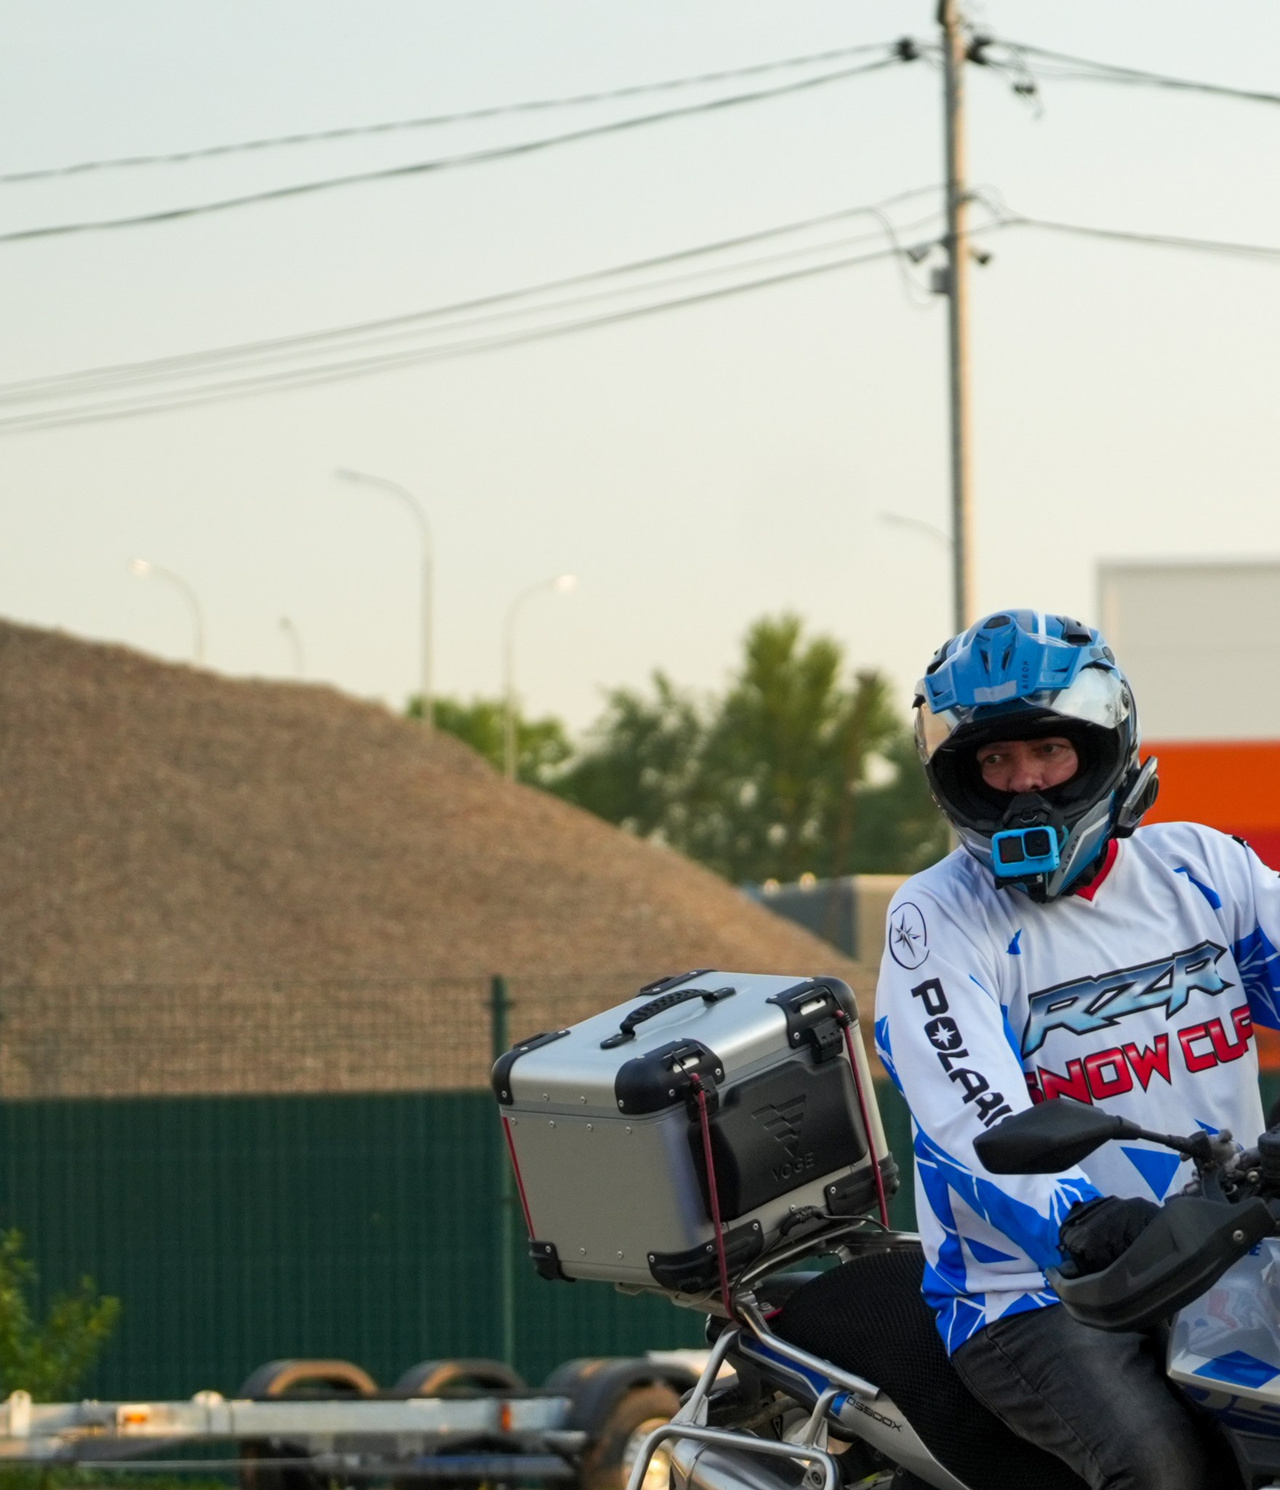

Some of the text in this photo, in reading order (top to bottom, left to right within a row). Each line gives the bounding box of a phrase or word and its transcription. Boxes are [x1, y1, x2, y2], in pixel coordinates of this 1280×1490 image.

[1022, 939, 1236, 1061] RZR
[911, 977, 1017, 1128] POLARI
[770, 1152, 815, 1182] VOGE
[846, 1396, 902, 1432] DS900X
